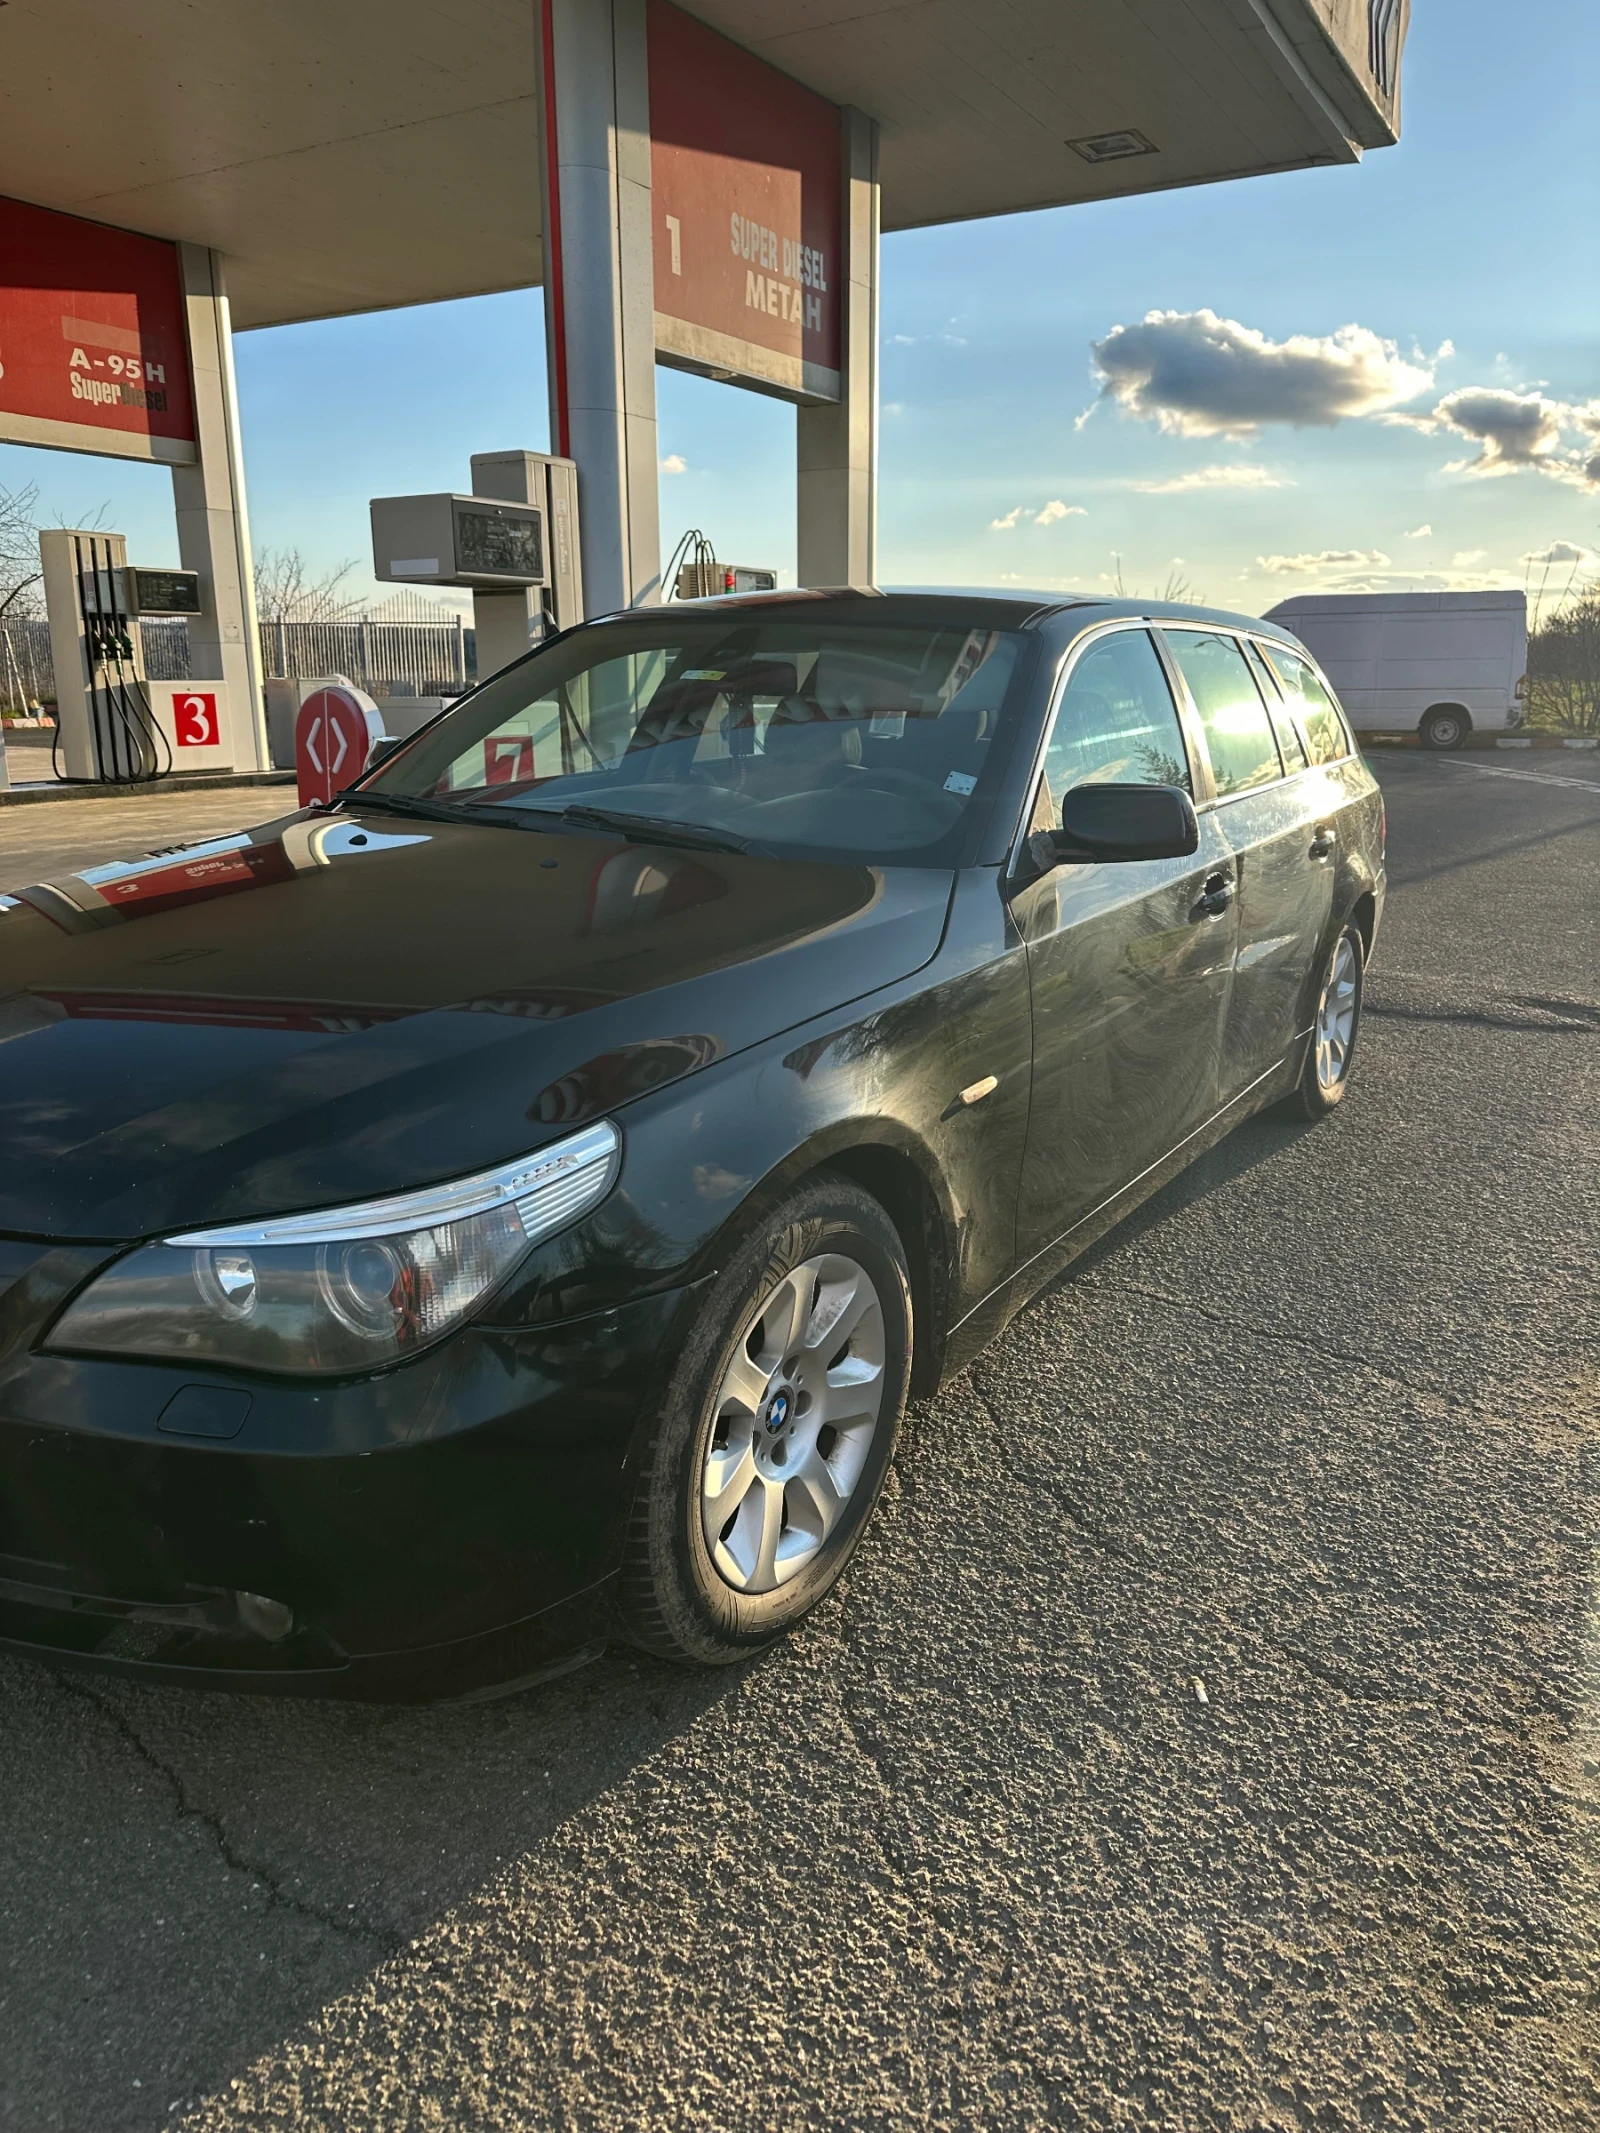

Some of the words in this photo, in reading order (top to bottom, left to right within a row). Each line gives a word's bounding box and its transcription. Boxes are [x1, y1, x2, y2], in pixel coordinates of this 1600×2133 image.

[666, 214, 682, 276] 1
[730, 212, 778, 272] SUPER
[782, 237, 828, 292] DIESEL
[183, 696, 210, 744] 3
[494, 743, 523, 782] 7
